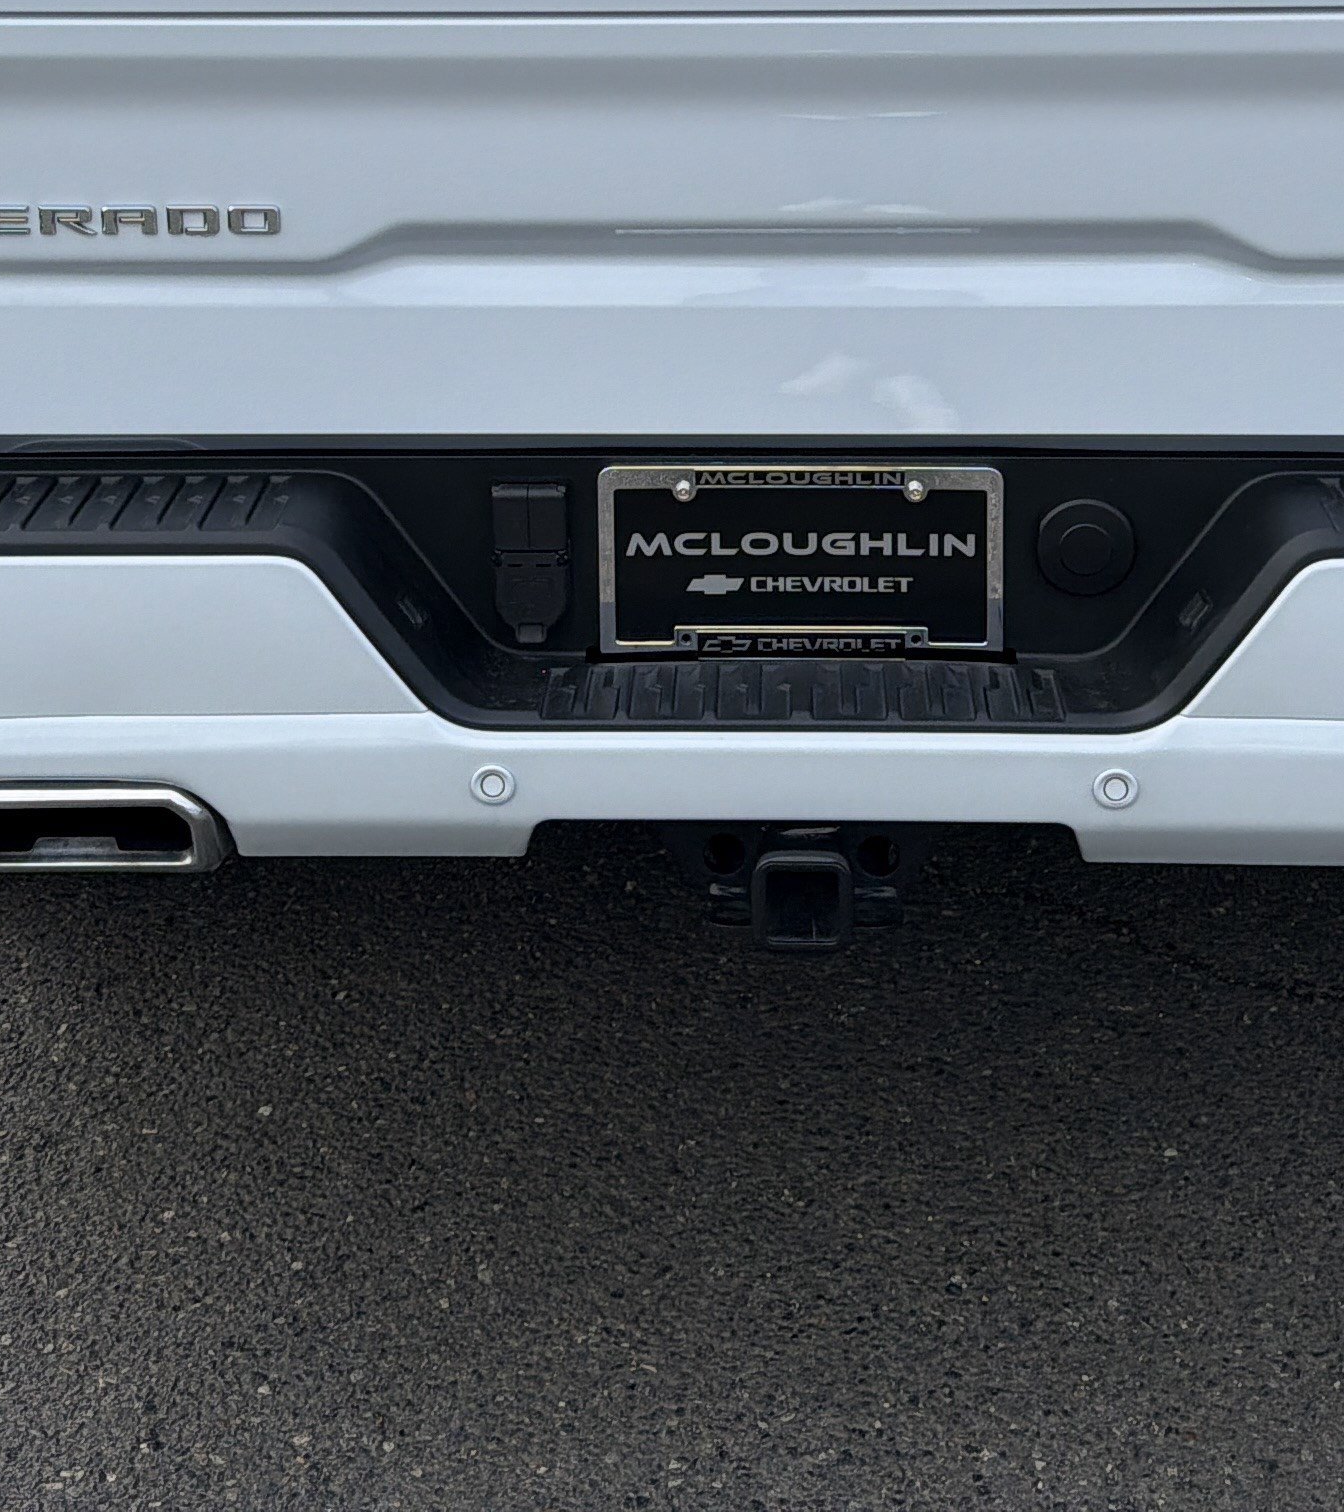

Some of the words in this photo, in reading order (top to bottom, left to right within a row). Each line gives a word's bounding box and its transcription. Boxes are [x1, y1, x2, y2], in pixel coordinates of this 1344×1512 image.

[699, 471, 903, 486] MCLOUGHLIN
[625, 531, 977, 558] MCLOUGHLIN
[749, 575, 914, 594] CHEVROLET
[756, 637, 903, 652] CHEVROLET
